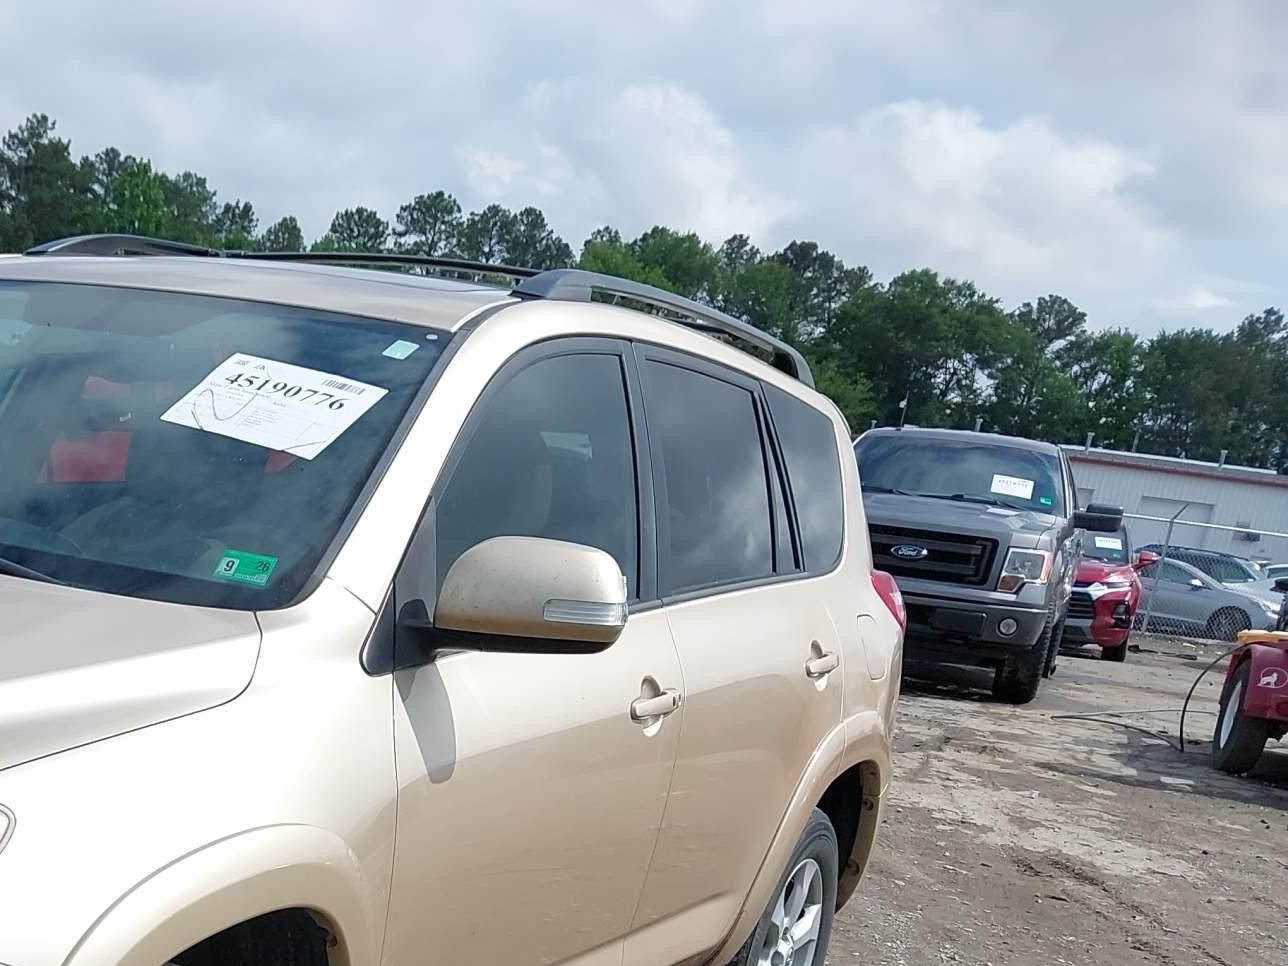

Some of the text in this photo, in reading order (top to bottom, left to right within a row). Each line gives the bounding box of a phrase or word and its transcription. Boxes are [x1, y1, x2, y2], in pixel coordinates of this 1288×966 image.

[225, 372, 347, 411] 45190776
[223, 560, 271, 573] 9 26
